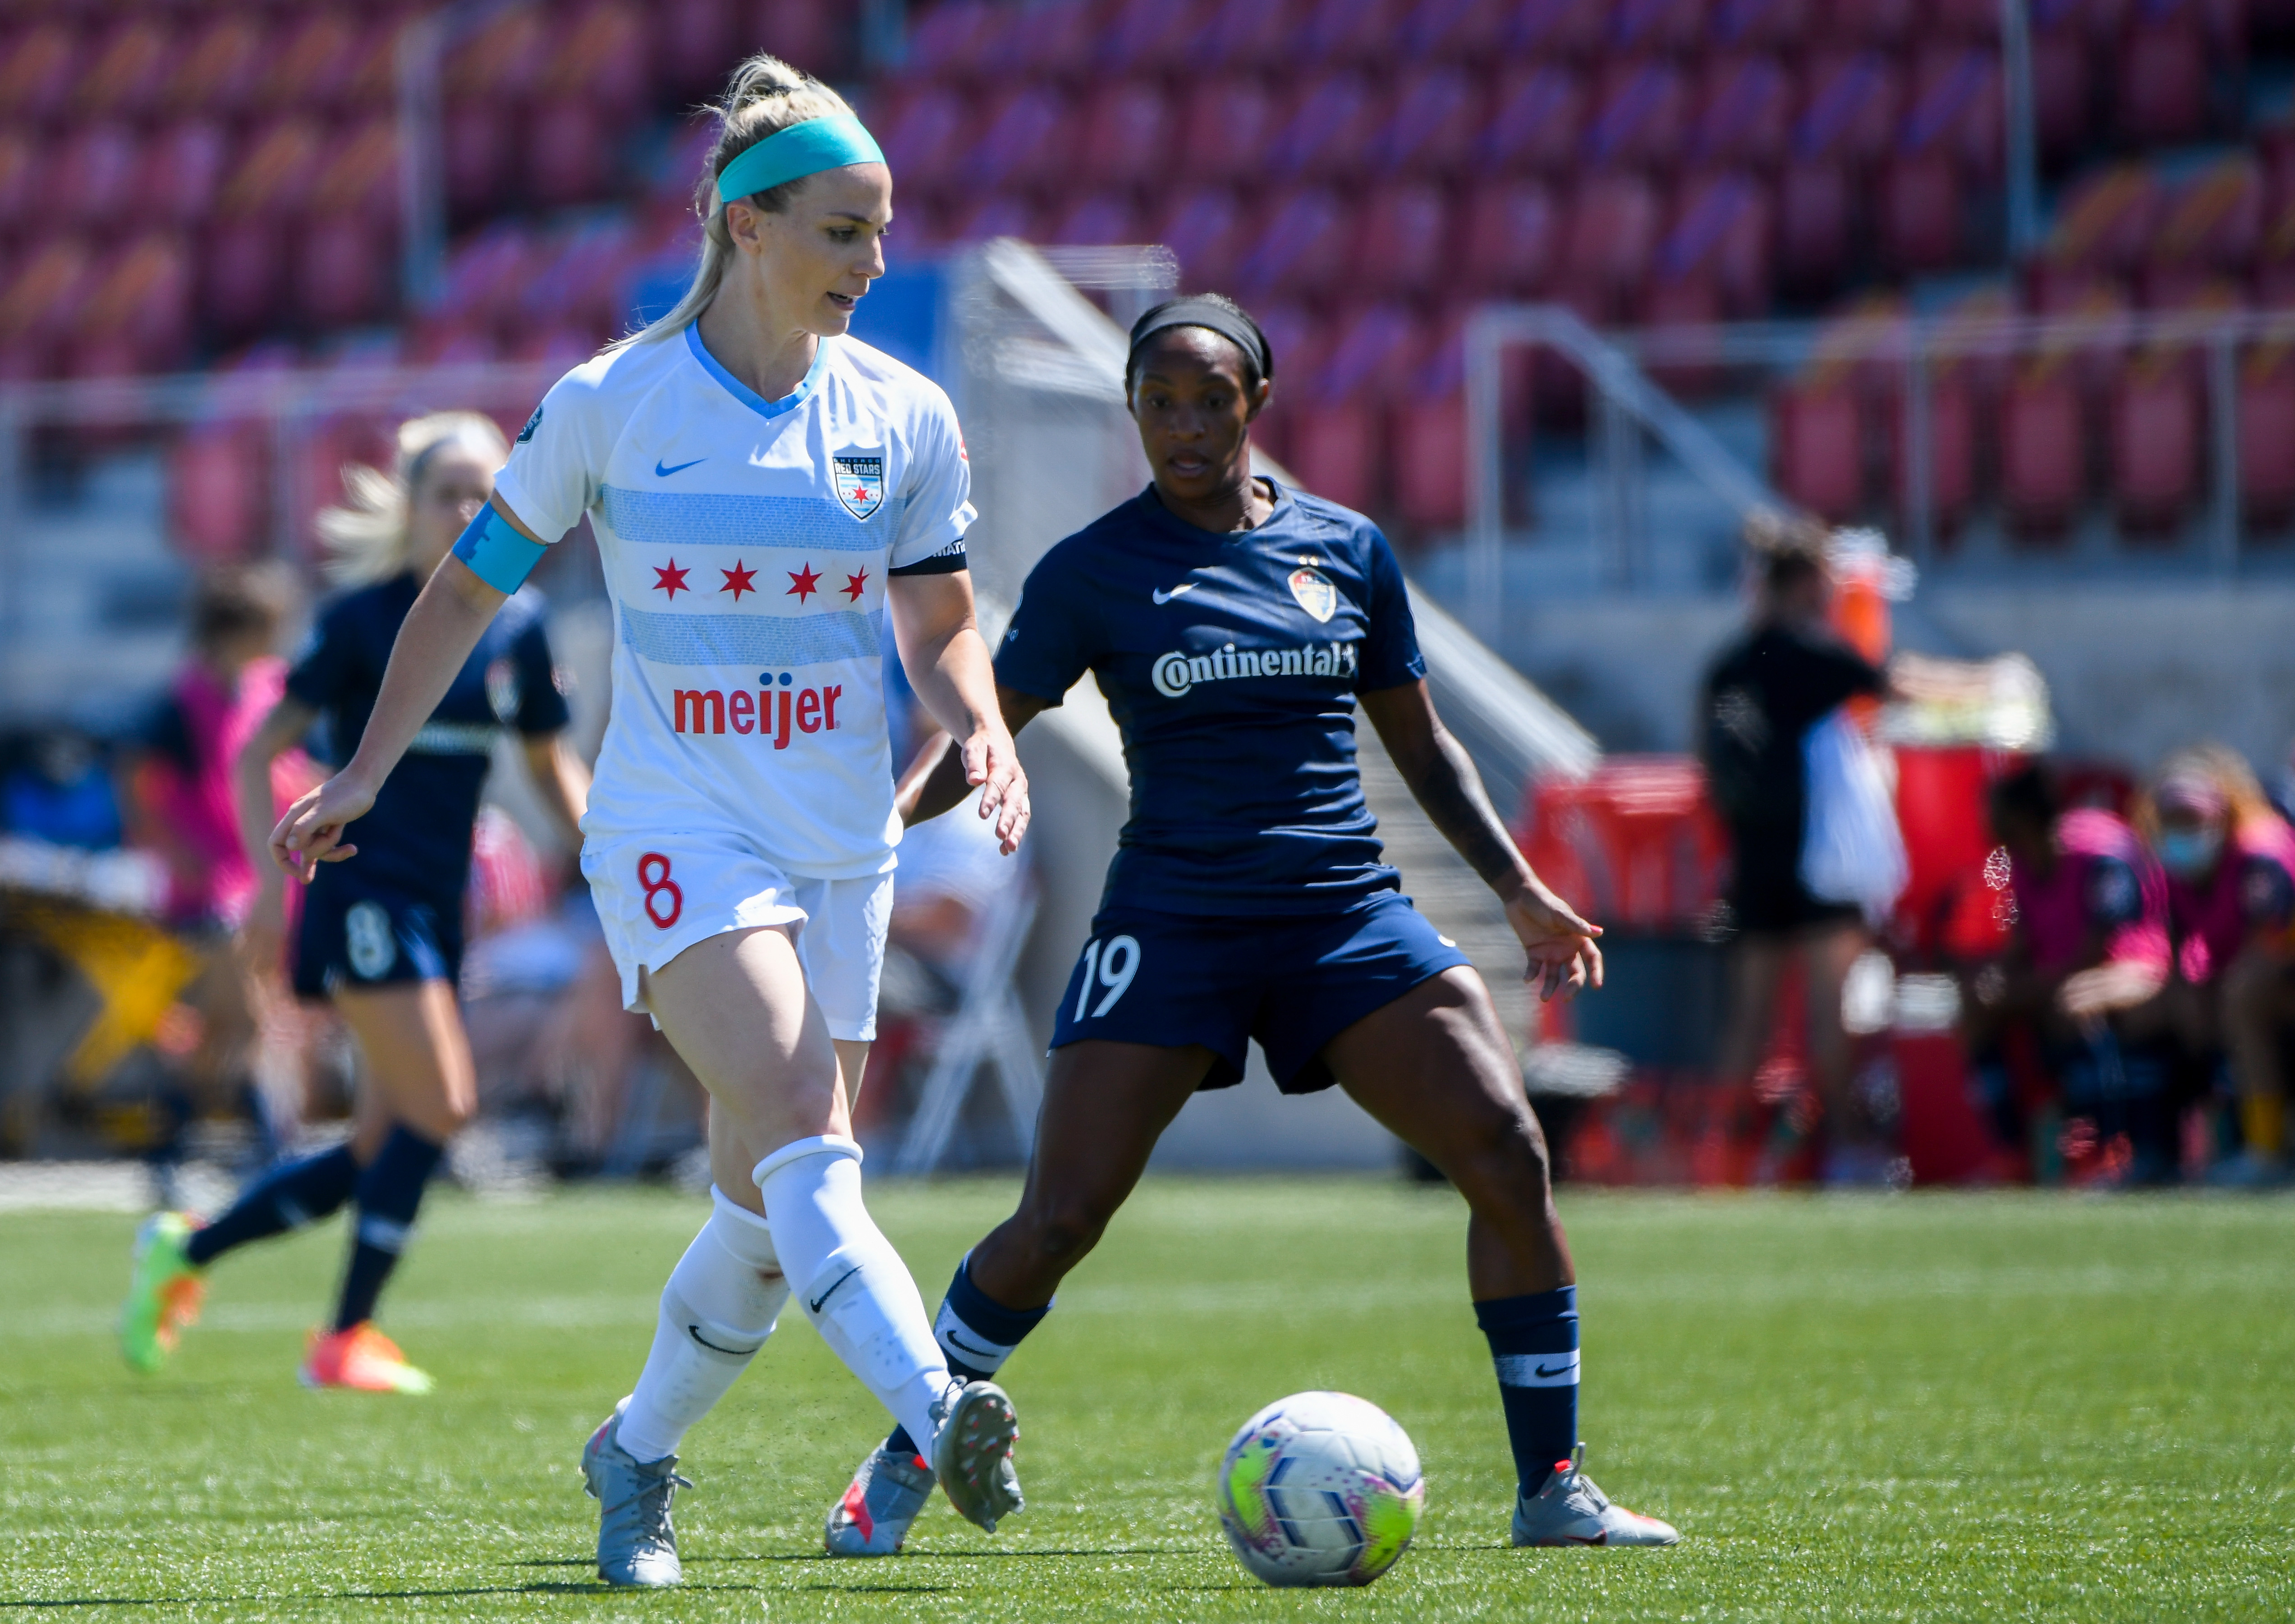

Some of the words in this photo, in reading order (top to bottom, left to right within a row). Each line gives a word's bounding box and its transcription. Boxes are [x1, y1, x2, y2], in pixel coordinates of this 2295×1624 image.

[835, 463, 852, 474] RED
[853, 464, 880, 474] STARS
[1152, 642, 1341, 698] Continental
[674, 672, 842, 749] meijer
[637, 851, 684, 930] 8
[345, 903, 398, 979] 8
[1073, 935, 1141, 1023] 19
